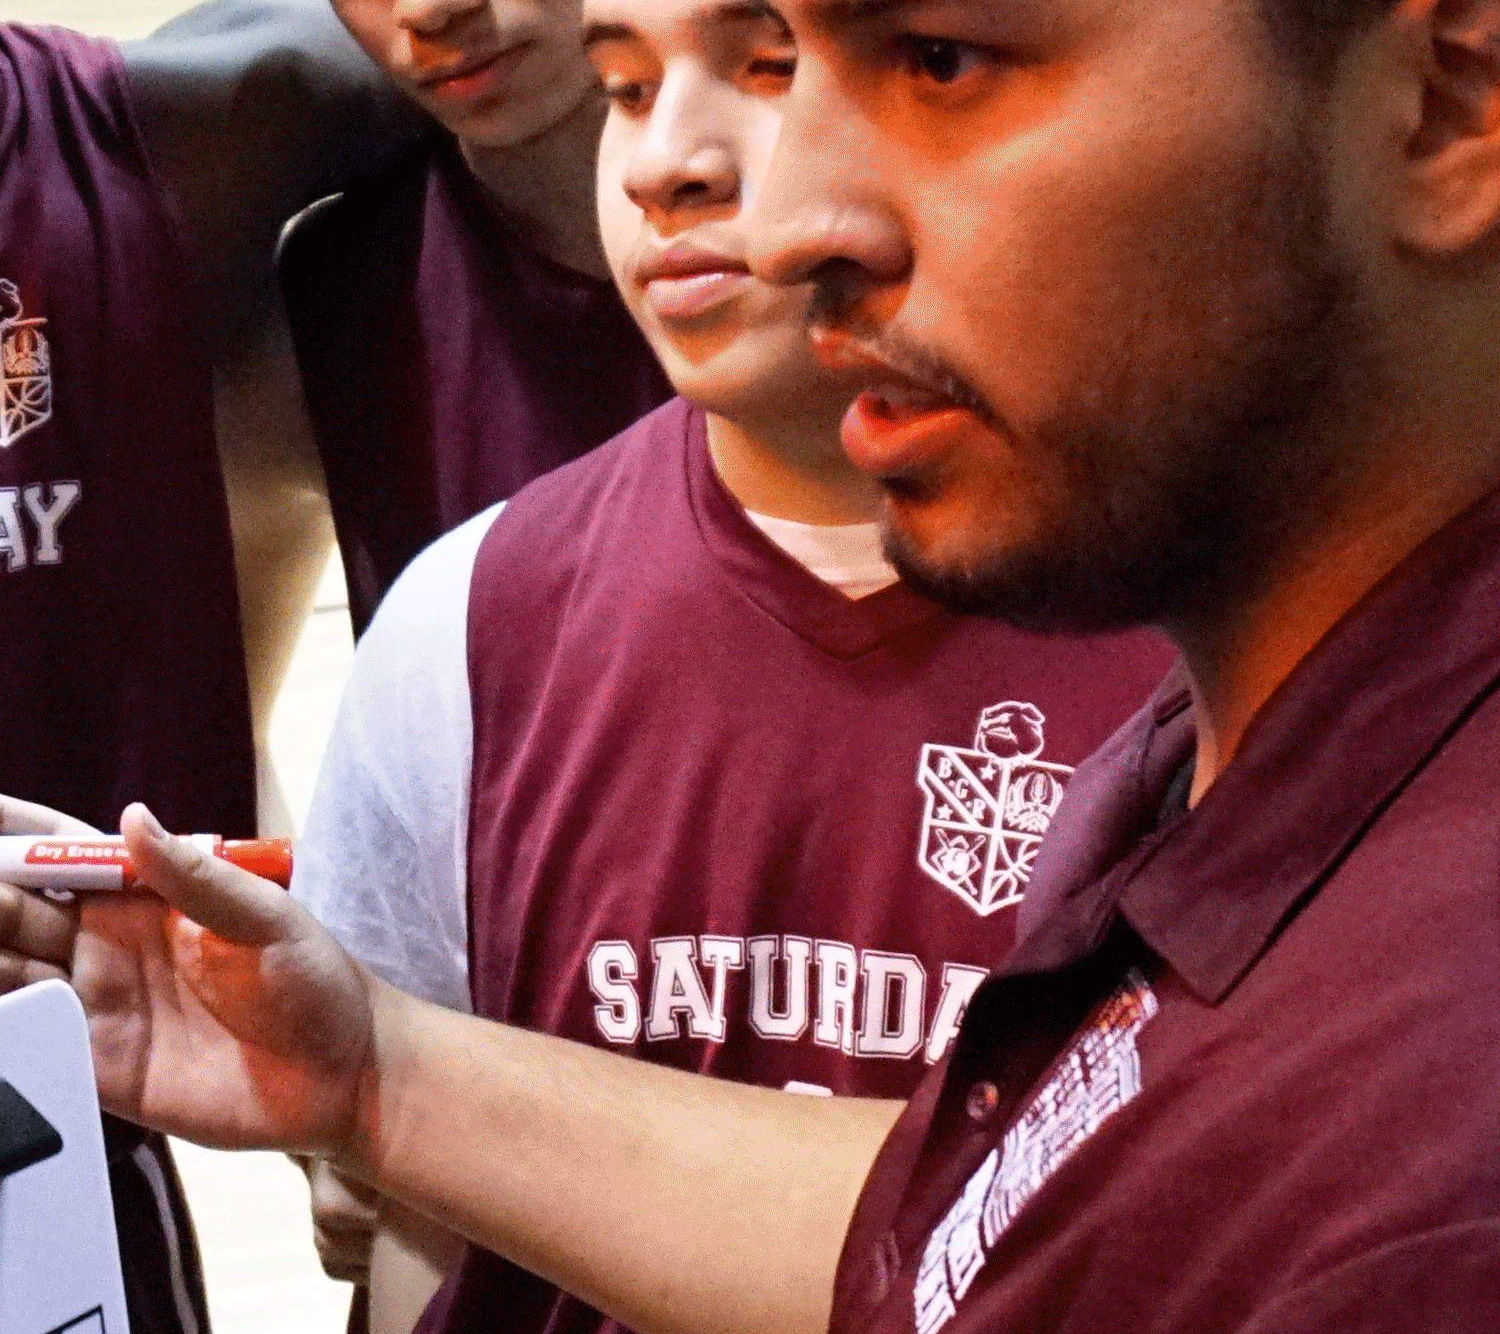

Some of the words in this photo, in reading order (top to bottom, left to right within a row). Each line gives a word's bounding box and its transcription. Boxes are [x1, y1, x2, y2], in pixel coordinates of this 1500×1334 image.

[35, 845, 63, 860] Dry
[66, 845, 114, 858] Erase
[587, 934, 990, 1065] SATURDA
